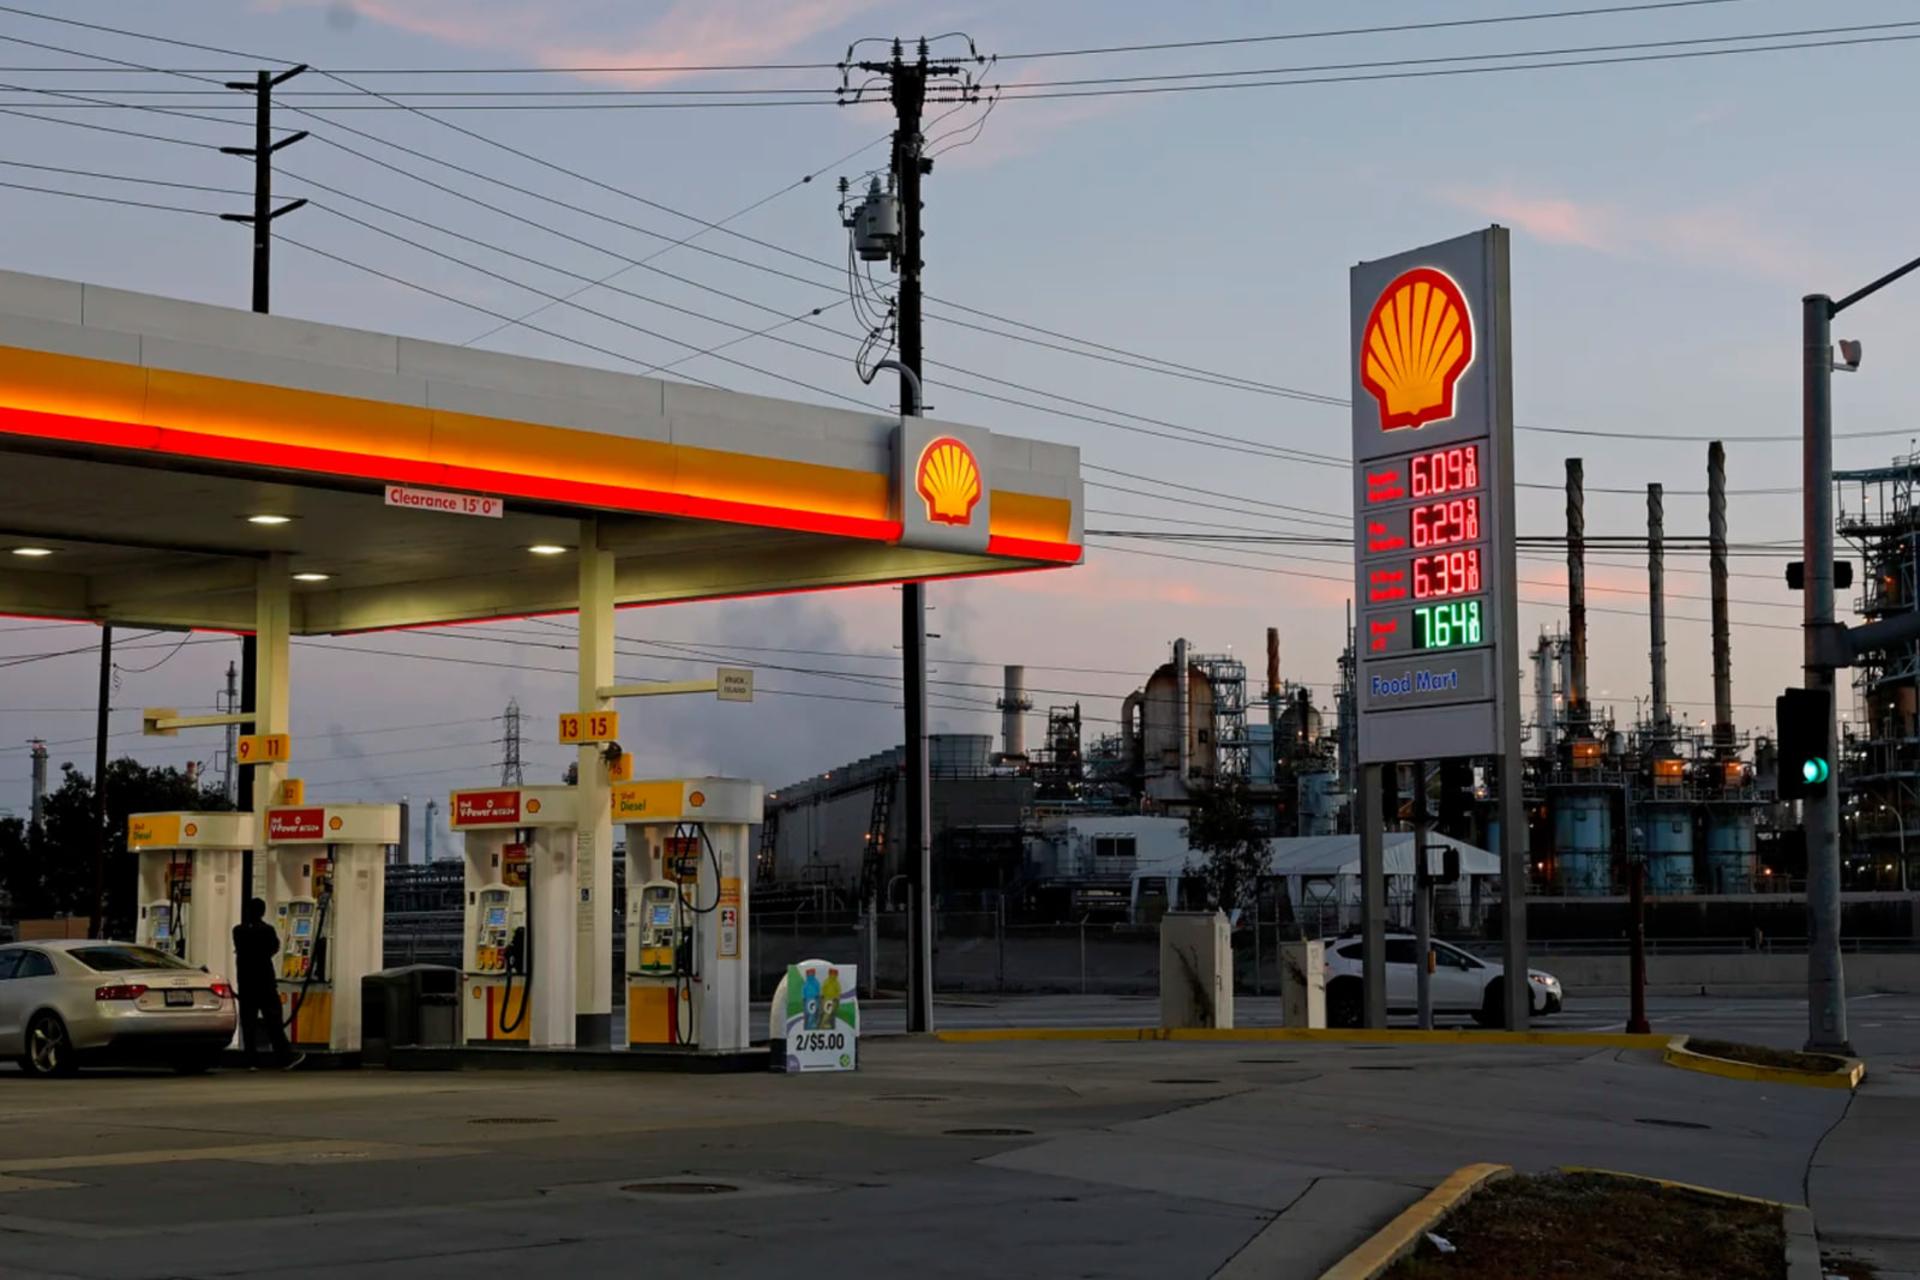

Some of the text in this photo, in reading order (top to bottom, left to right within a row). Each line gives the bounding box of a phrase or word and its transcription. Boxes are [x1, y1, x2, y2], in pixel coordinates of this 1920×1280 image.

[1412, 450, 1462, 497] 6.09
[390, 488, 457, 510] Clearance
[1413, 501, 1464, 548] 6.29
[1414, 552, 1465, 598] 6.39
[1415, 602, 1467, 648] 7.64
[1371, 668, 1457, 696] Food Mart
[561, 717, 607, 738] 13 15
[240, 739, 279, 758] 9 11
[796, 1032, 845, 1052] 2/$5.00
